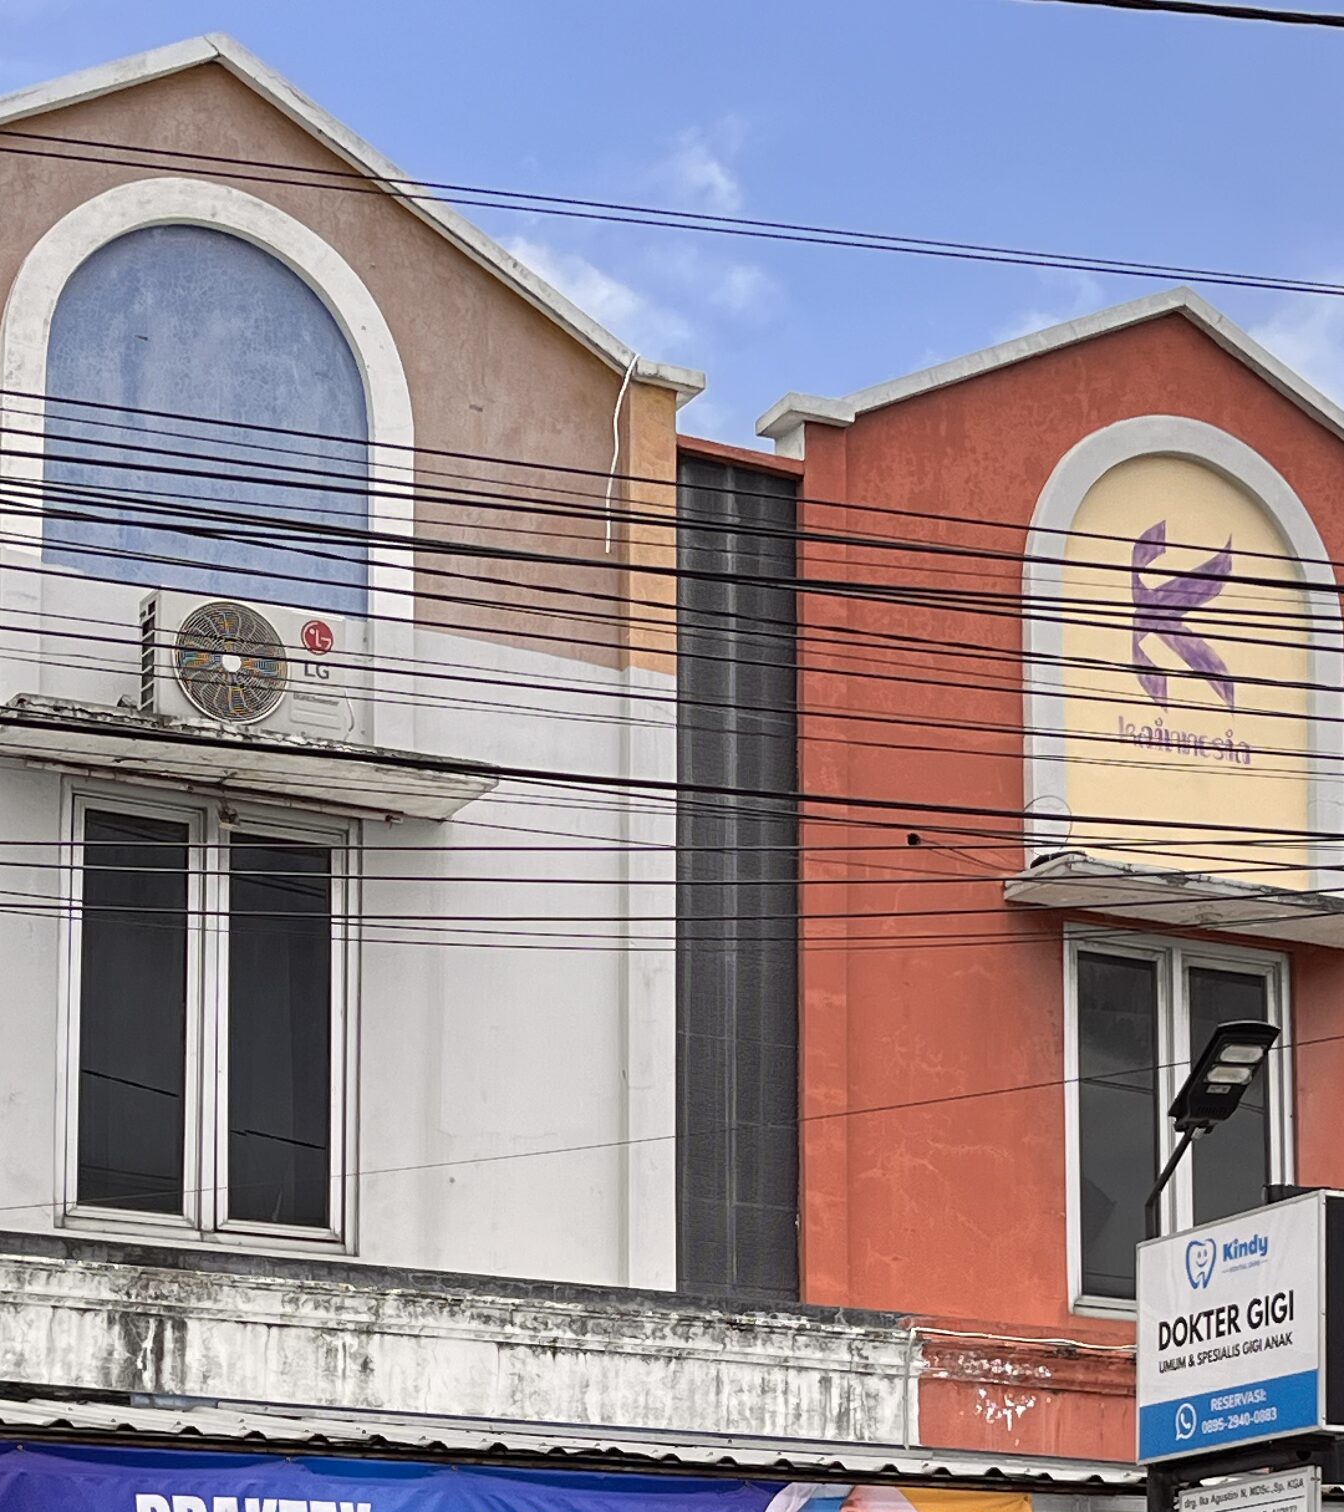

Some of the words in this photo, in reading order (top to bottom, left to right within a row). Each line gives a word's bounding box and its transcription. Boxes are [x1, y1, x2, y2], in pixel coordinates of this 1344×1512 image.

[304, 663, 329, 680] LG
[1223, 1234, 1268, 1262] Kindy
[1158, 1304, 1241, 1351] DOKTER
[1247, 1289, 1294, 1330] GIGI
[1159, 1356, 1186, 1373] UMUM
[1188, 1354, 1195, 1367] &
[1197, 1344, 1240, 1365] SPESIALIS
[1242, 1339, 1262, 1355] GIGI
[1264, 1332, 1293, 1350] ANAK
